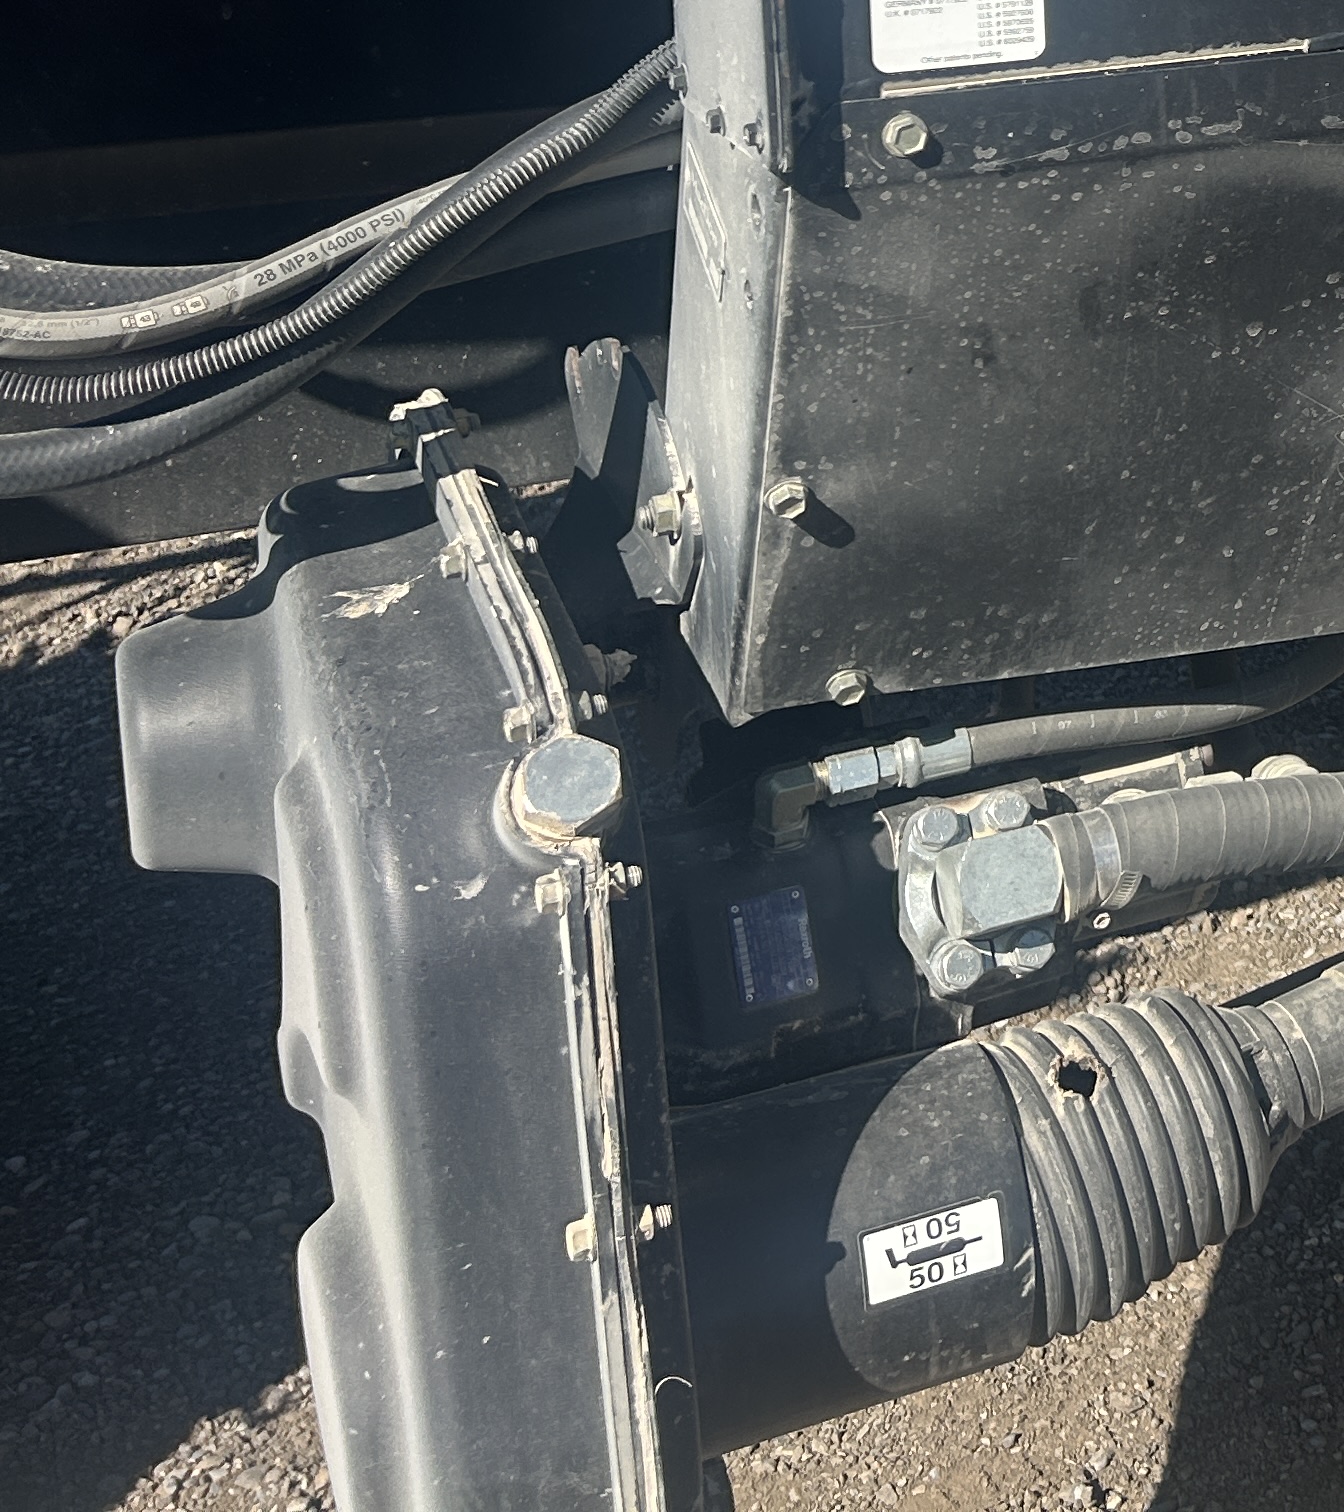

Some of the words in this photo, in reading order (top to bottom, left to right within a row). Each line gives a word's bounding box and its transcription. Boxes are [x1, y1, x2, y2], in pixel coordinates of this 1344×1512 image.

[254, 269, 276, 287] 28
[278, 251, 318, 276] MPa
[320, 226, 367, 256] (4000
[368, 209, 406, 233] PSI)
[926, 1212, 960, 1239] 50
[909, 1262, 944, 1288] 50
